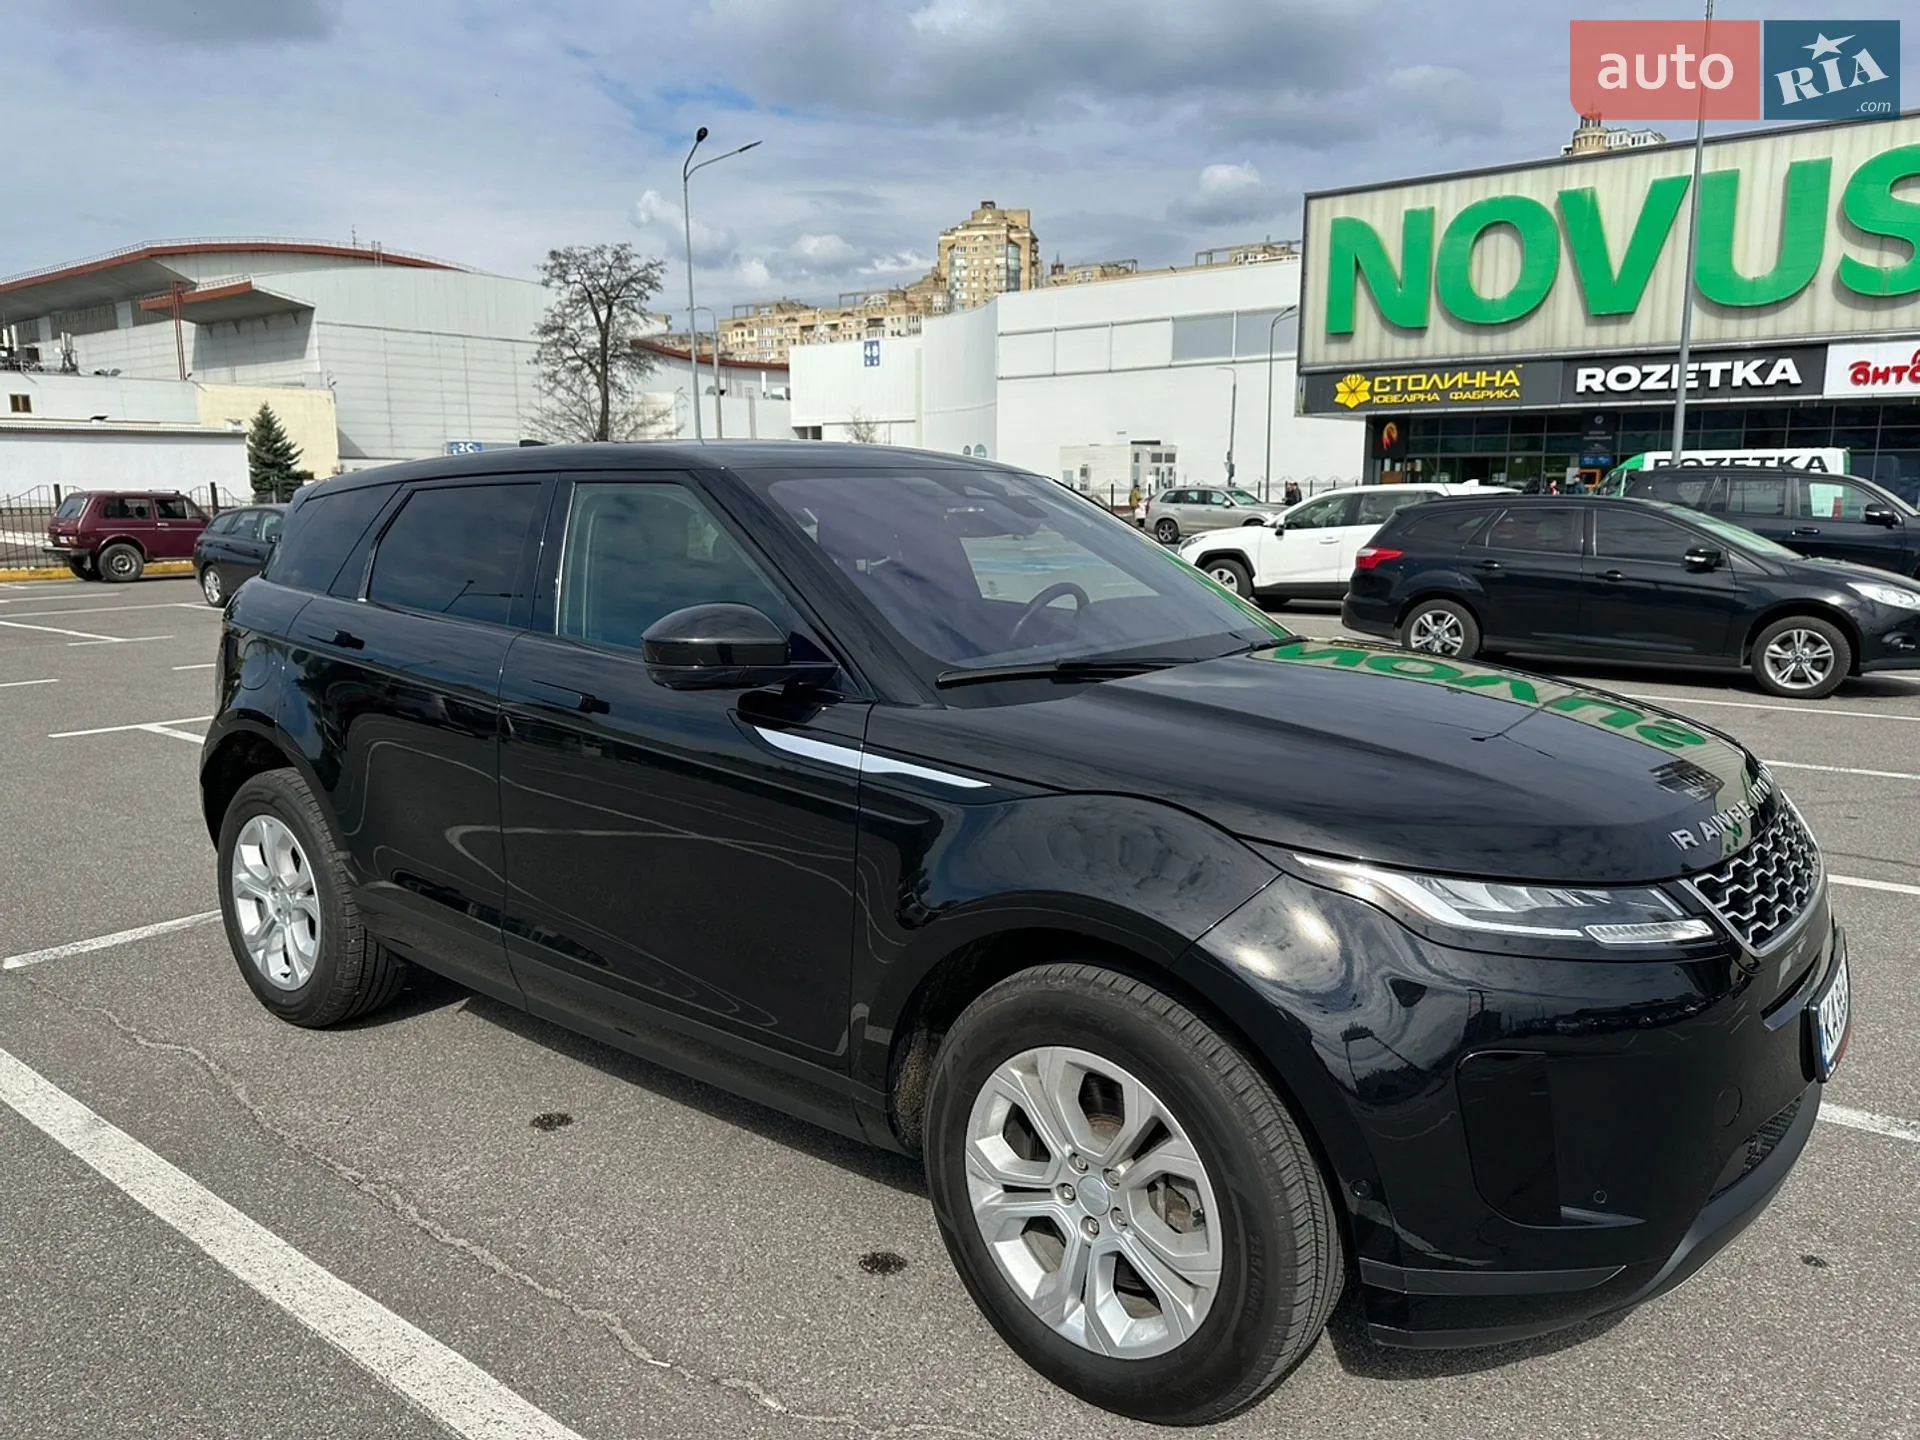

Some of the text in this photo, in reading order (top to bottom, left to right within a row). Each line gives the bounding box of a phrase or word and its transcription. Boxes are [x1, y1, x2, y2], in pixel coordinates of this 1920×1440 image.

[1326, 144, 1920, 334] NOVUS
[1373, 369, 1520, 393] СТОЛИЧНА
[1576, 358, 1802, 393] ROZETKA
[1373, 389, 1520, 405] ЮВЕЛІРНА ФАБРИКА
[1667, 800, 1755, 852] RANGE
